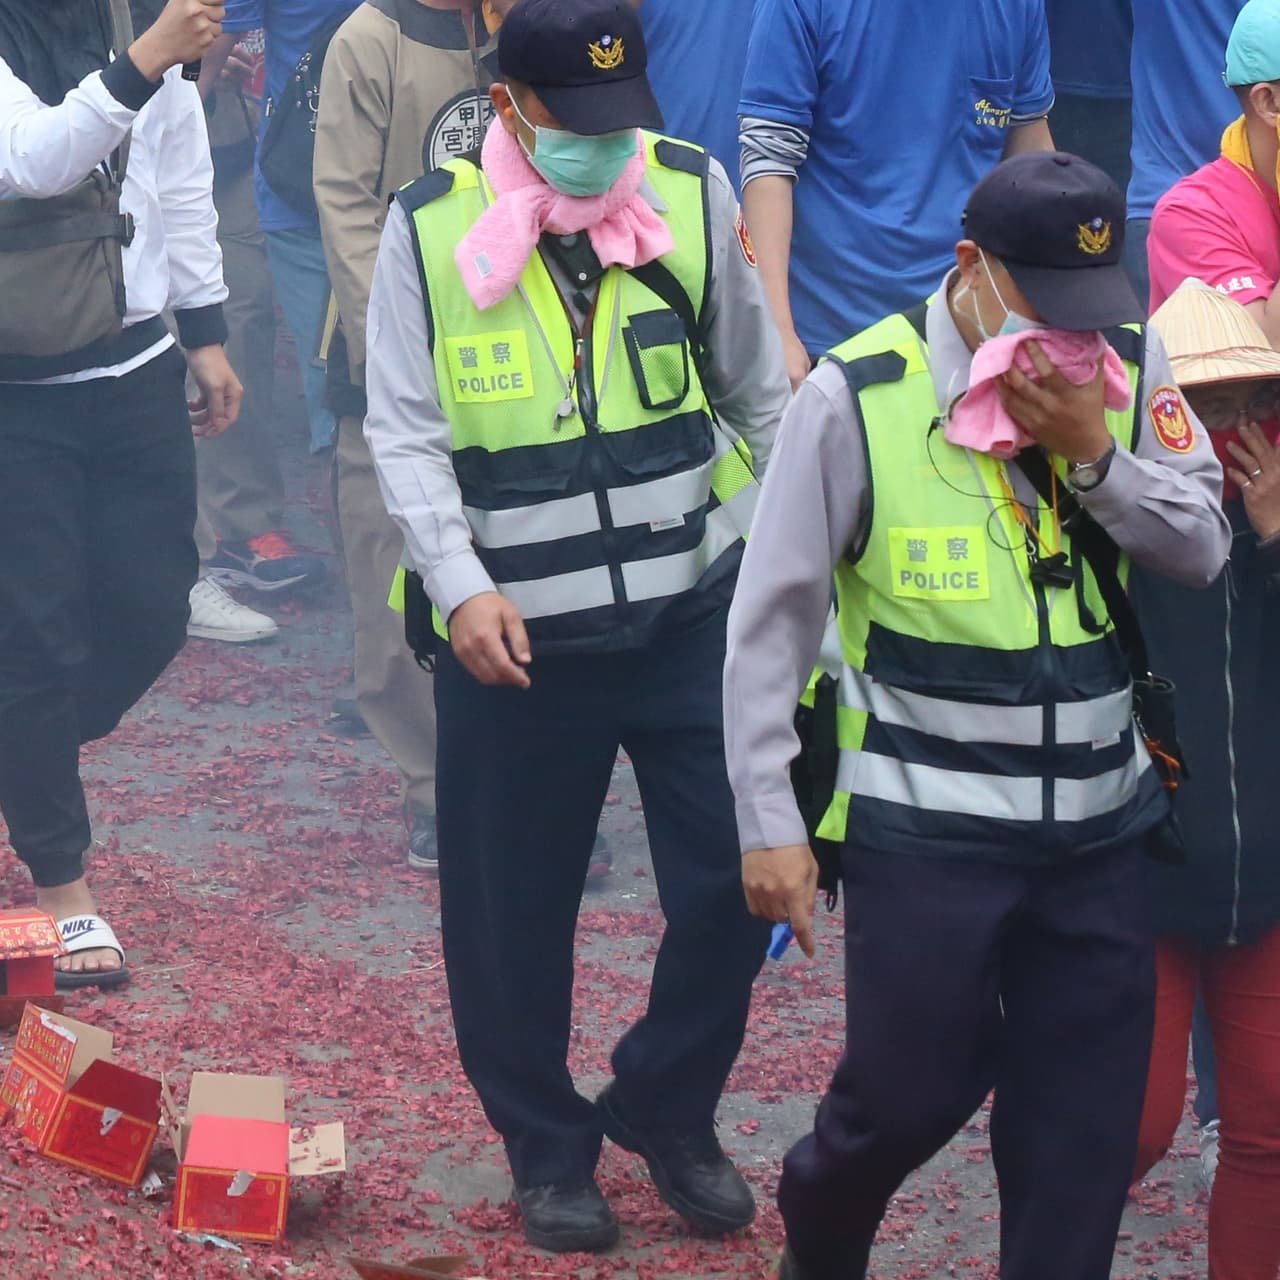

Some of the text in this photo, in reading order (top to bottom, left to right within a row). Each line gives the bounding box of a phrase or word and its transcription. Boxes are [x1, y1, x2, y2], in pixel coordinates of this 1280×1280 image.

[457, 341, 512, 369] 警察
[457, 371, 525, 394] POLICE
[905, 536, 969, 562] 警察
[900, 569, 980, 591] POLICE
[61, 918, 97, 936] NIKE
